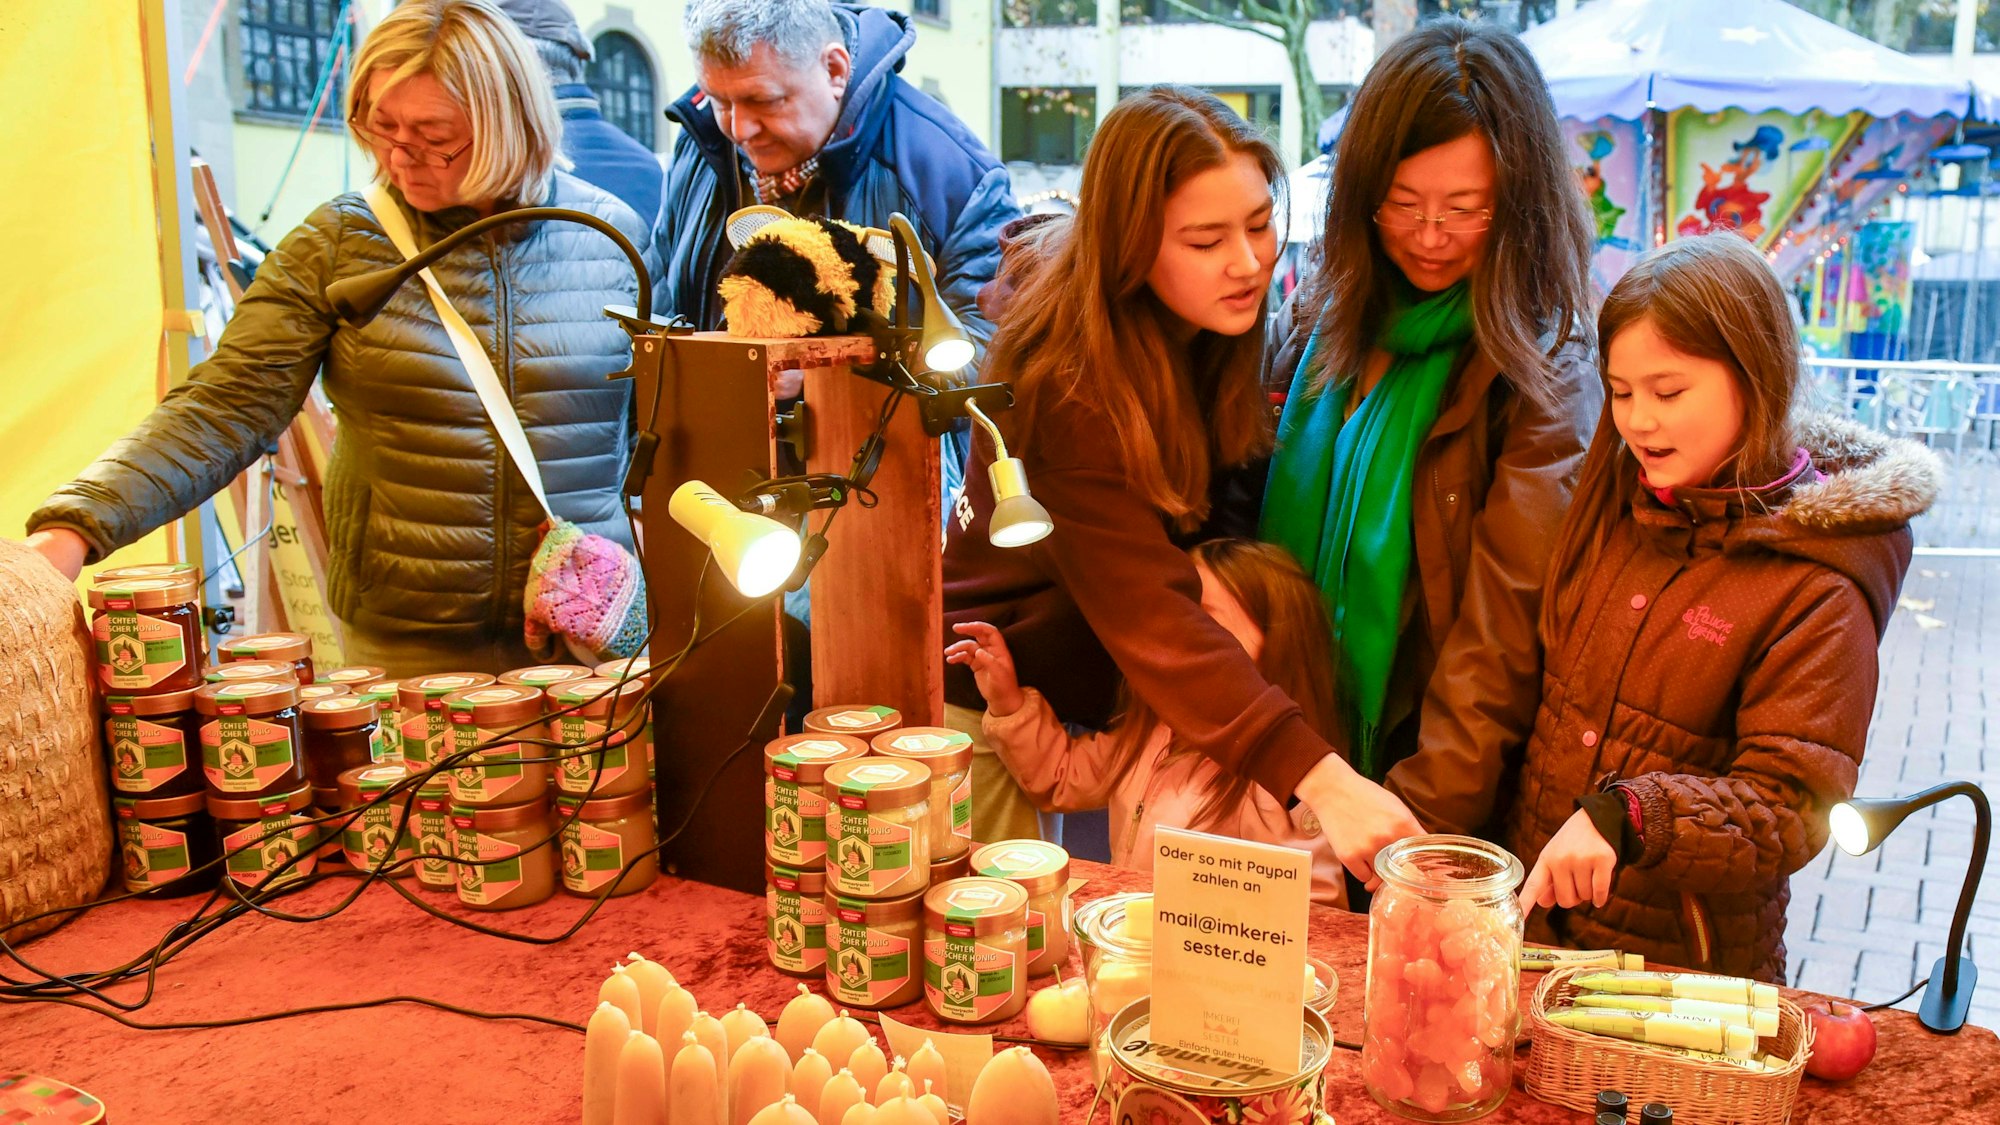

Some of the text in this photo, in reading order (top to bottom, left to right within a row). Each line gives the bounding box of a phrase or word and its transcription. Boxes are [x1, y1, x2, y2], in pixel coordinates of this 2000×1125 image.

[132, 623, 161, 632] HONIG
[219, 722, 248, 730] ECHTER
[243, 727, 271, 737] HONIG
[133, 730, 161, 738] HONIG
[774, 784, 798, 798] ECHTER
[793, 798, 821, 809] HONIG
[840, 814, 869, 826] ECHTER
[863, 825, 892, 836] HONIG
[1160, 845, 1297, 880] Oder so mit Paypal
[1192, 872, 1261, 893] zahlen an
[776, 894, 801, 907] ECHTER
[795, 906, 823, 916] HONIG
[839, 926, 867, 939] ECHTER
[1159, 910, 1294, 946] mail@imkerei-
[861, 938, 889, 948] HONIG
[945, 942, 975, 954] ECHTER
[969, 953, 997, 963] HONIG
[1183, 939, 1267, 967] sester.de
[1203, 1010, 1241, 1026] IMKEREI
[1202, 1032, 1240, 1047] SESTER
[1178, 1039, 1212, 1054] Einfach
[1212, 1046, 1237, 1060] guter
[1237, 1053, 1265, 1066] Honig
